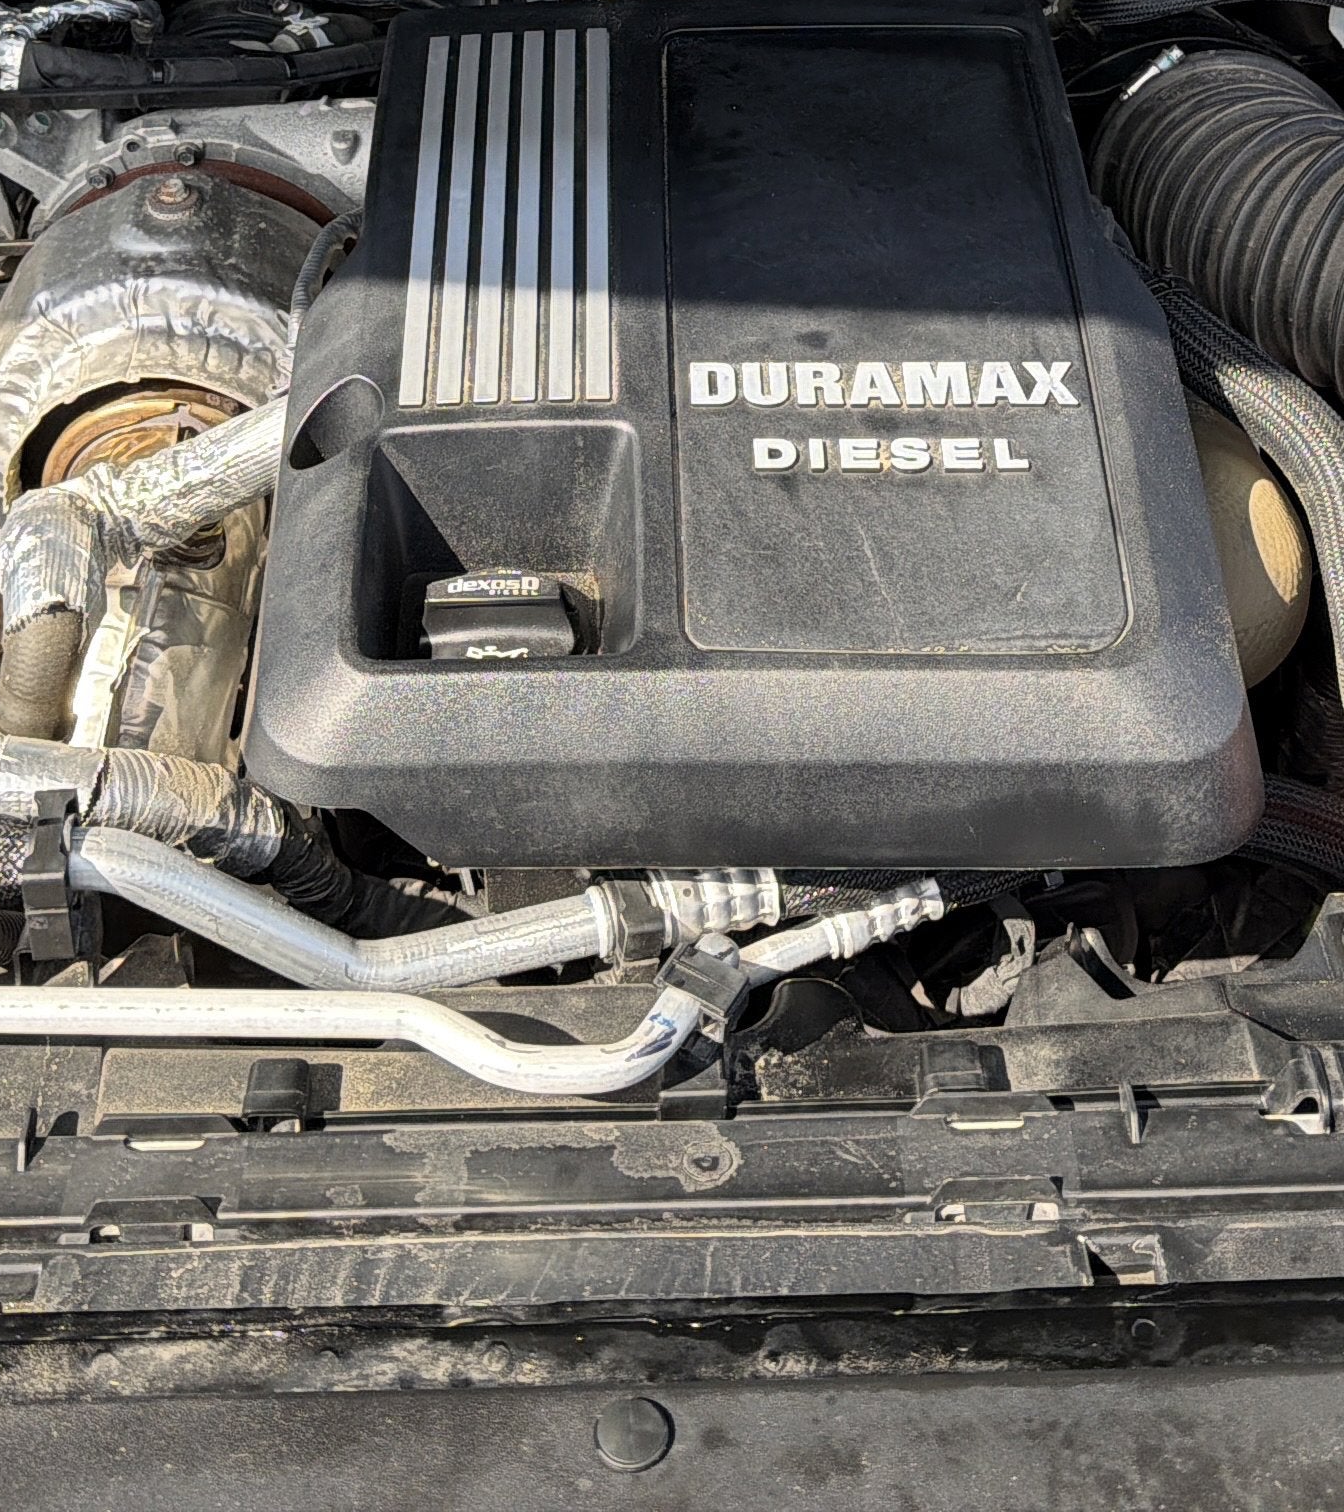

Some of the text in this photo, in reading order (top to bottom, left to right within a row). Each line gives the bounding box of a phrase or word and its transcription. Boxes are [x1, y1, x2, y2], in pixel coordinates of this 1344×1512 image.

[689, 361, 1080, 407] DURAMAX
[752, 437, 1031, 472] DIESEL
[447, 576, 541, 594] dexosD
